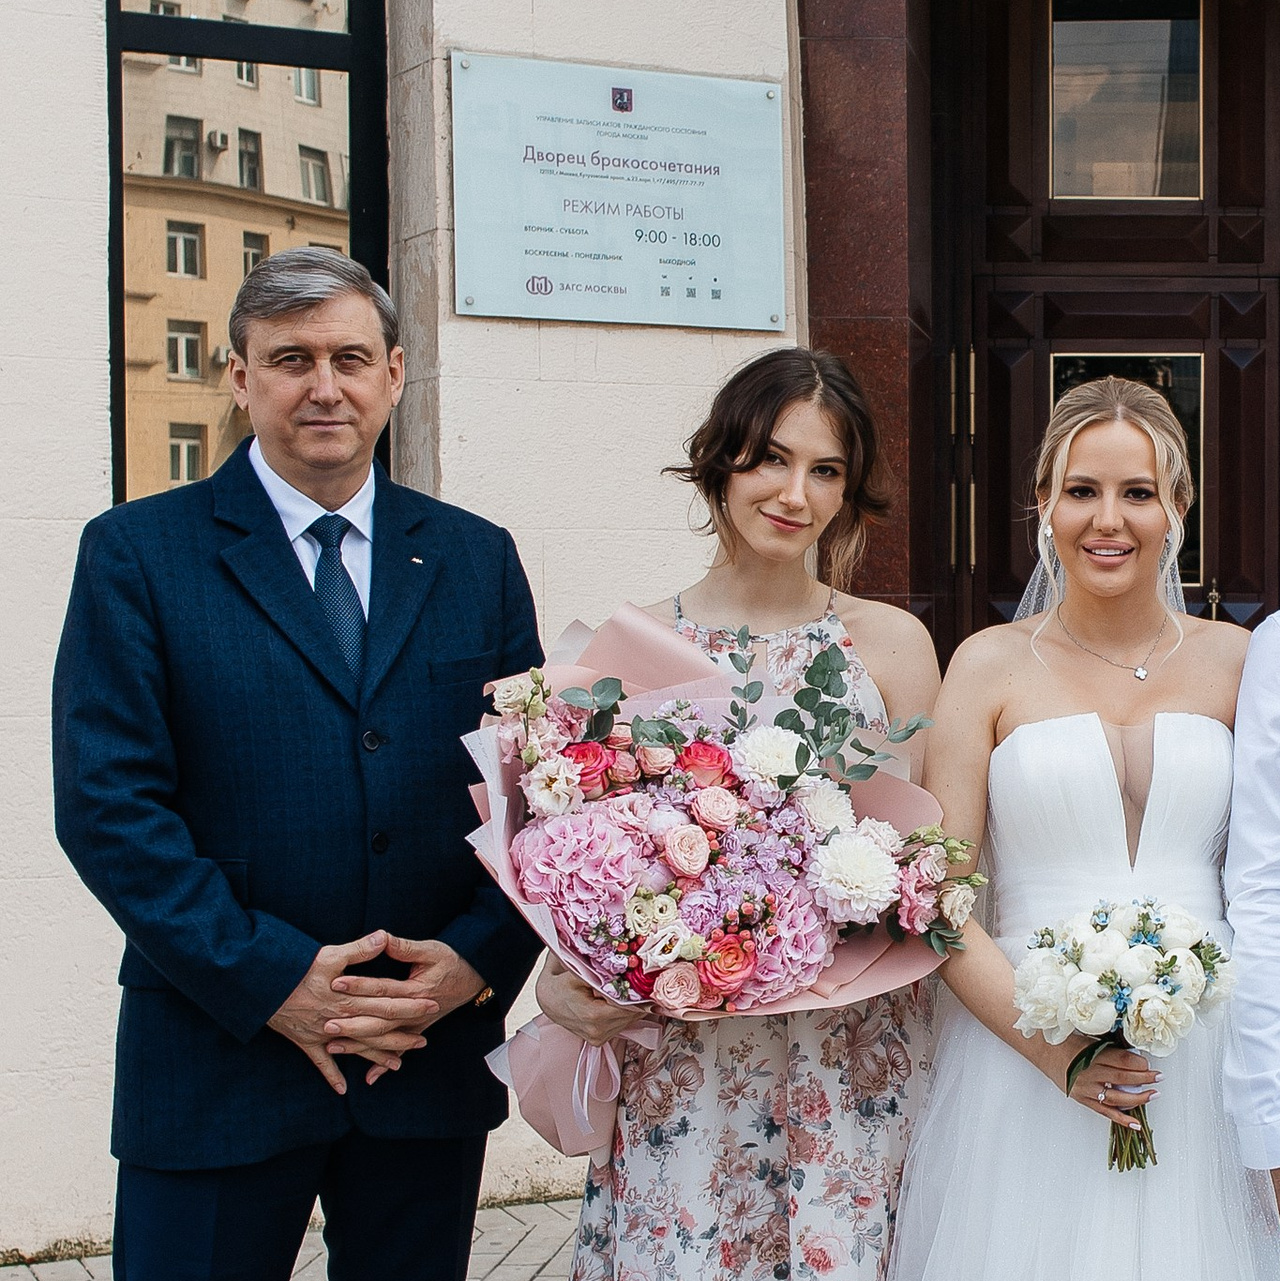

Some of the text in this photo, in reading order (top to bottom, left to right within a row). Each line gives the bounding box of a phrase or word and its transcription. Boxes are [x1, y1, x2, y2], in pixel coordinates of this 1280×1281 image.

[522, 145, 721, 176] Дворец бракосочетания
[563, 198, 684, 221] РЕЖИМ РАБОТЫ
[524, 225, 554, 233] ВТОРНИК
[559, 227, 589, 236] СУББОТА
[634, 228, 668, 244] 9:00
[683, 232, 721, 248] 18:00
[574, 251, 623, 261] ПОНЕДЕЛЬНИК
[659, 258, 696, 266] ВЫХОДНОЙ
[559, 282, 627, 295] ЗАГС МОСКВЫ
